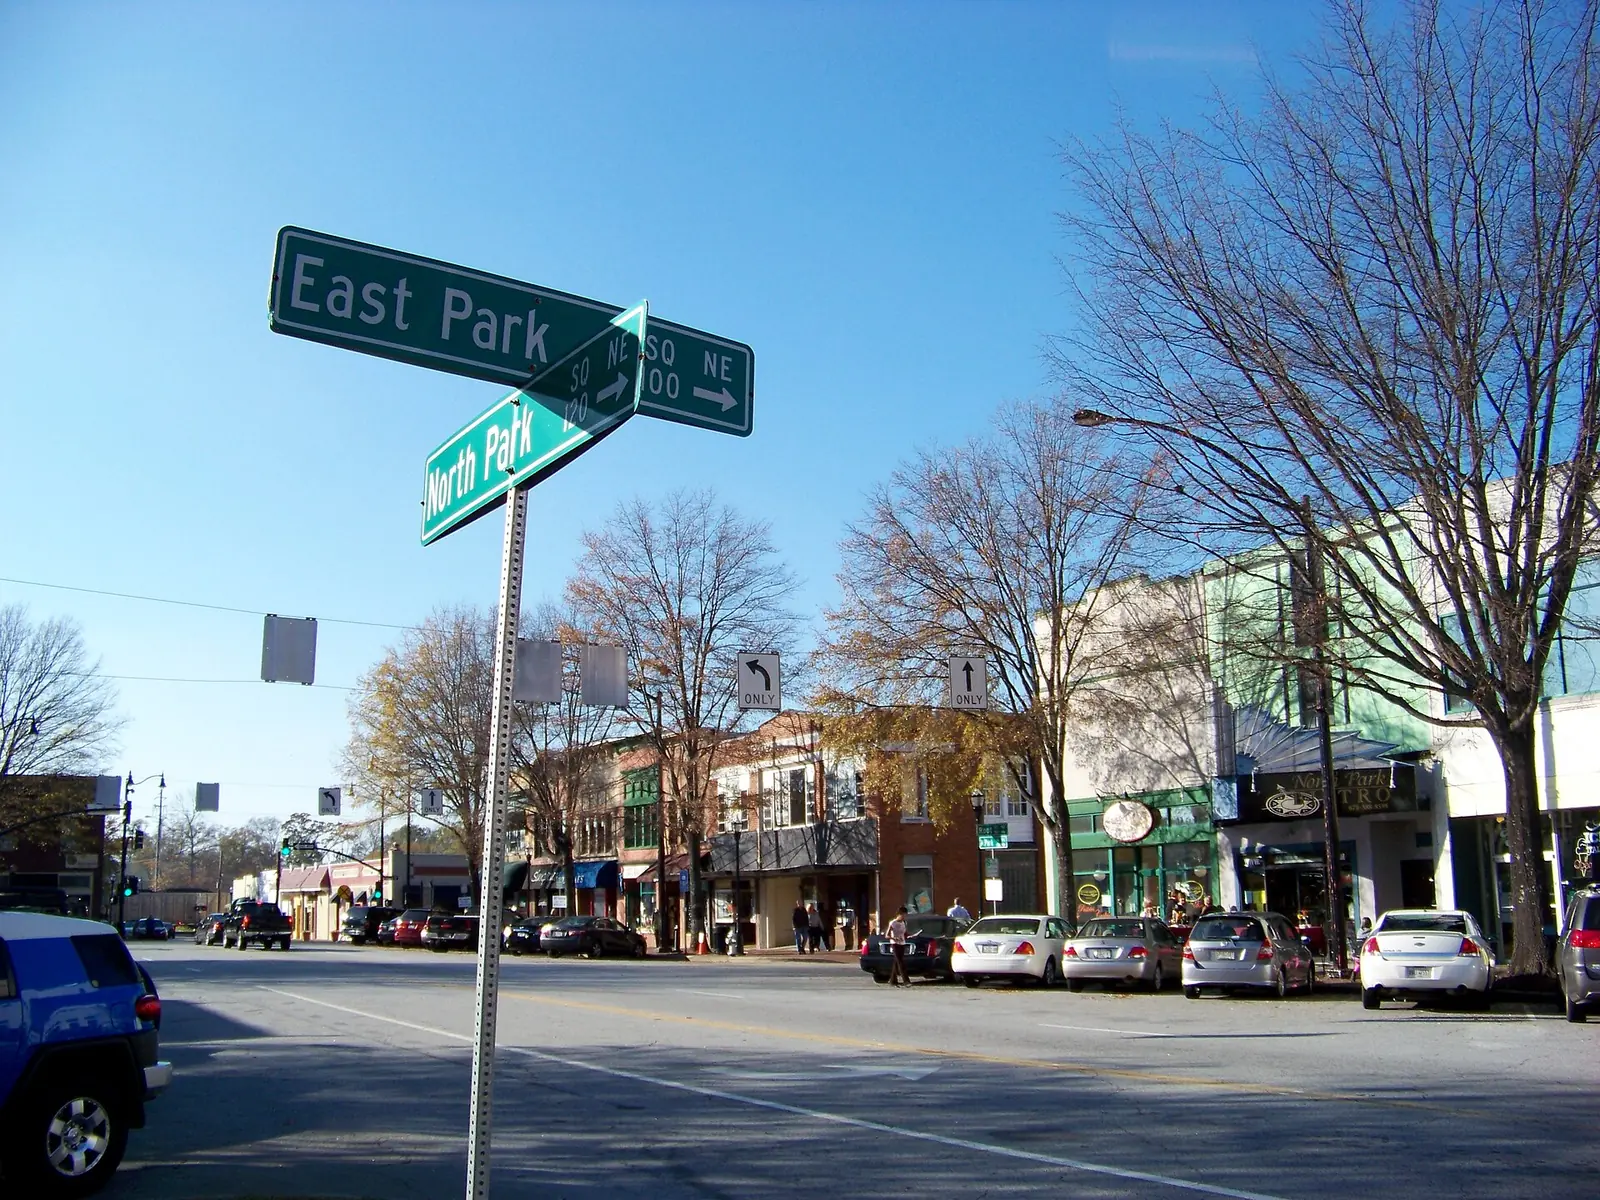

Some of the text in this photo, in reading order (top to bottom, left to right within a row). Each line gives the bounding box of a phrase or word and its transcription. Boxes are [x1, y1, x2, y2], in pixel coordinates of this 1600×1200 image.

[290, 253, 550, 363] East Park
[570, 329, 631, 392] SQ NE
[645, 334, 733, 382] SQ NE
[563, 391, 588, 433] 120
[426, 403, 534, 521] North Park
[744, 693, 776, 705] ONLY
[956, 694, 983, 705] ONLY
[1345, 769, 1386, 787] Park
